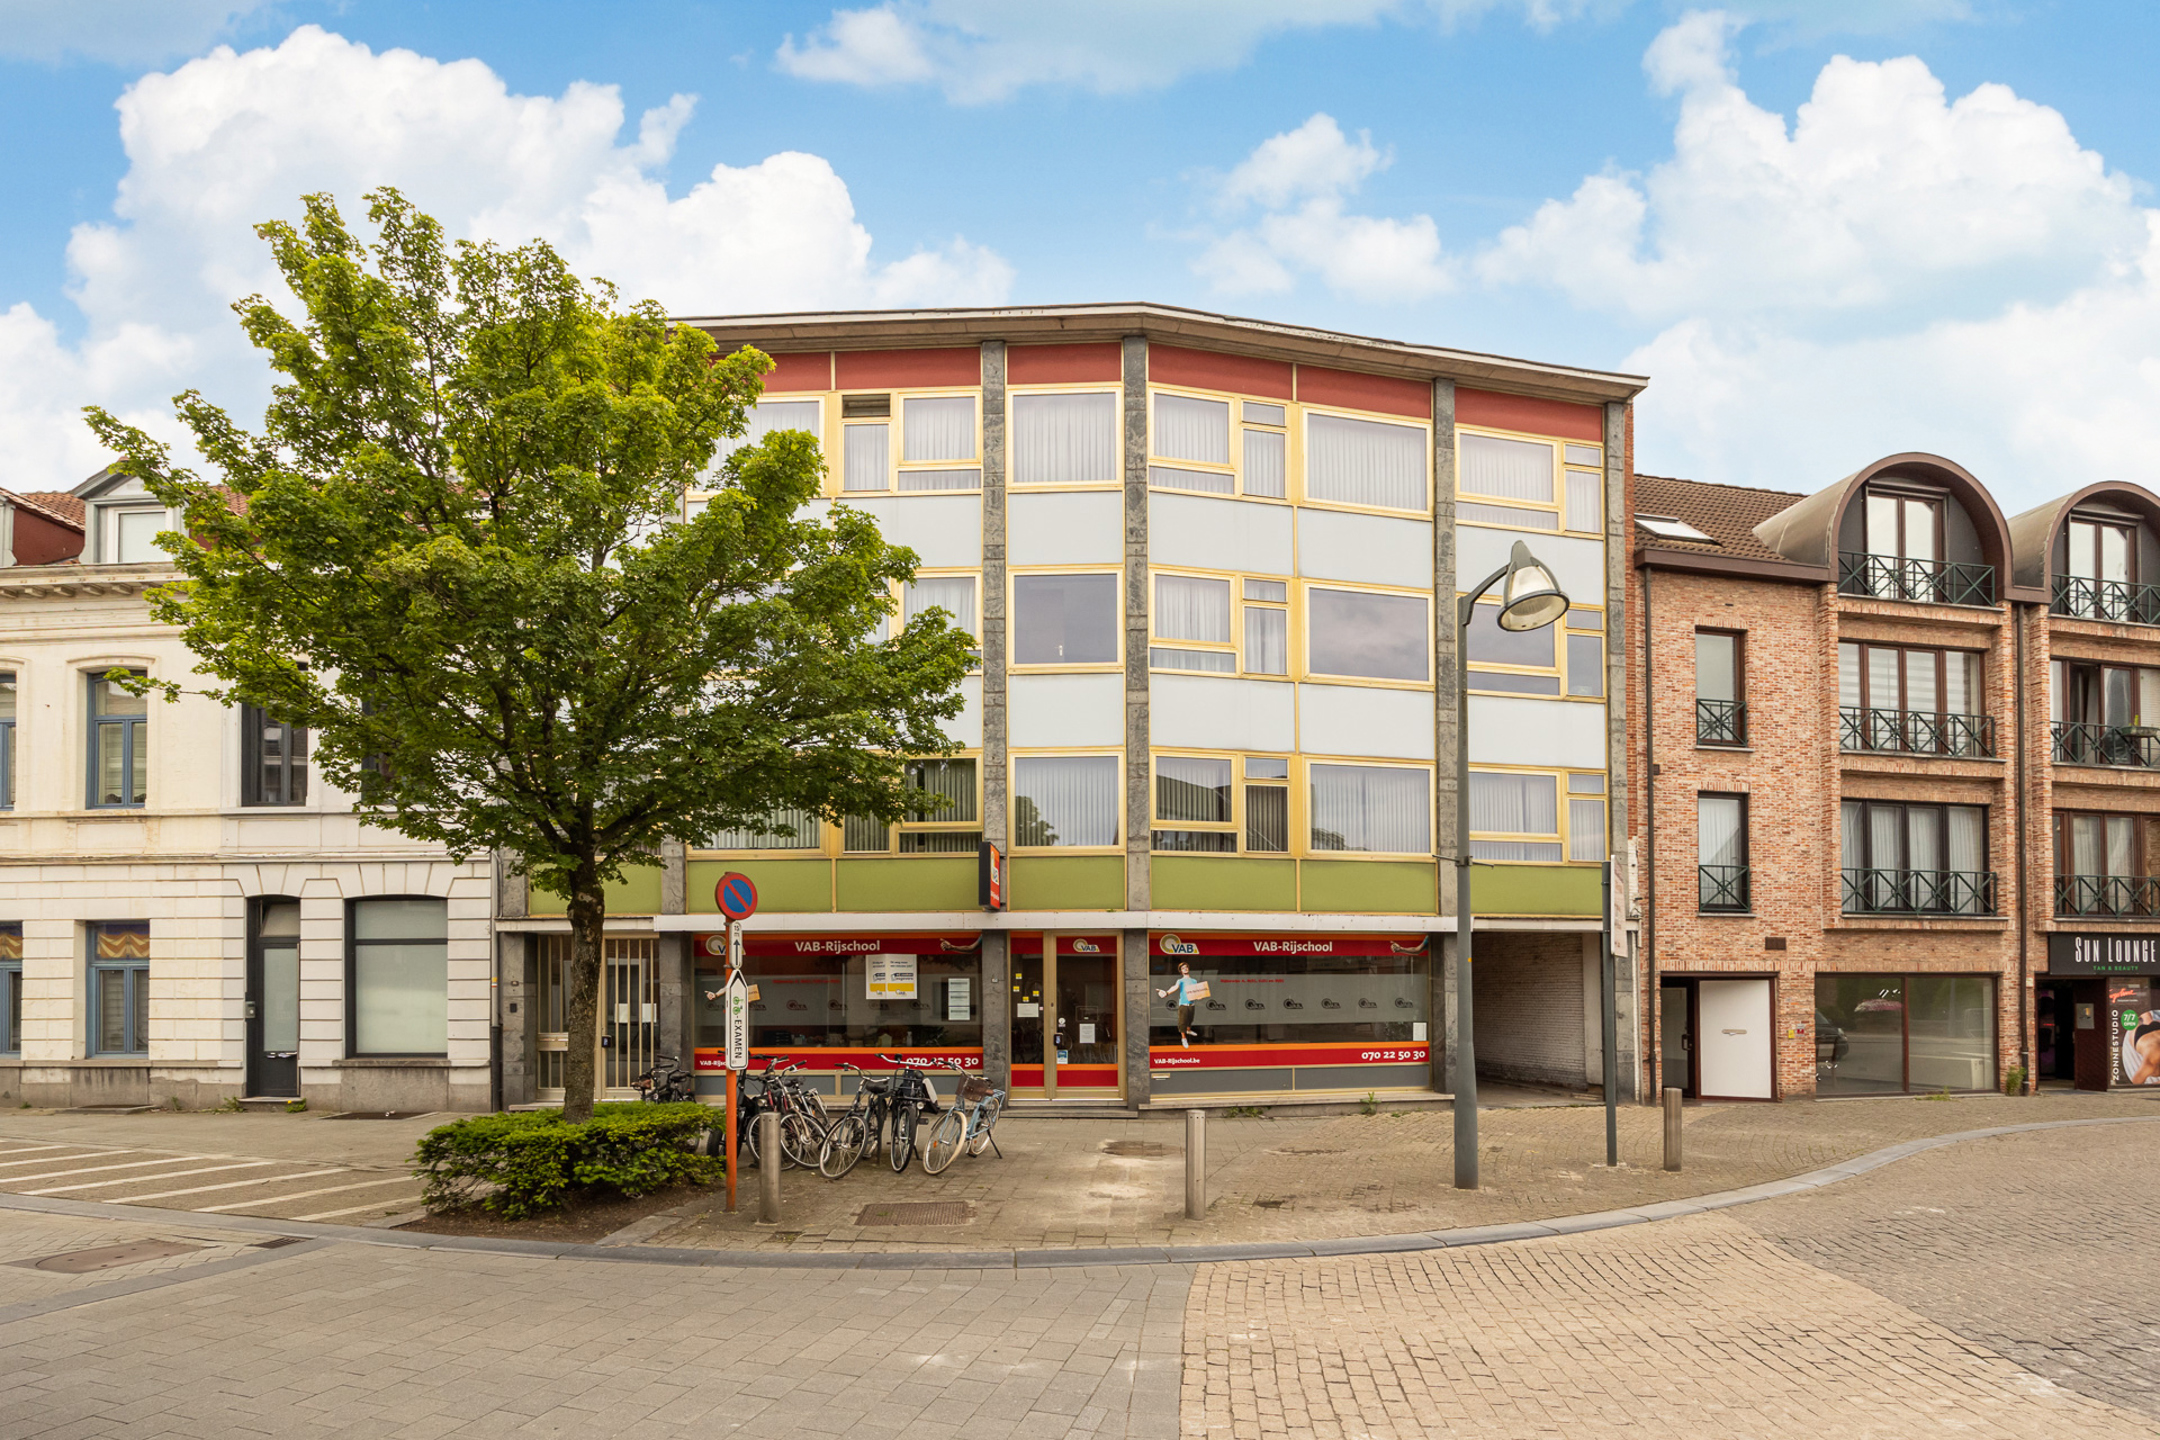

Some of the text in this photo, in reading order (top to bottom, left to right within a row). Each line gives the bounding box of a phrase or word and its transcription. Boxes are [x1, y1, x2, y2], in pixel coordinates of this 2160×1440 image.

[795, 940, 880, 954] VAB-Rijschool
[1171, 944, 1194, 953] VAB
[1253, 941, 1333, 954] VAB-Rijschool
[2075, 936, 2156, 962] SUN LOUNGE
[2123, 1013, 2136, 1022] 7/7
[2111, 1009, 2119, 1081] ZONNESTUDIO
[1361, 1050, 1426, 1061] 070 22 50 30
[906, 1057, 928, 1067] 070
[964, 1057, 979, 1067] 30
